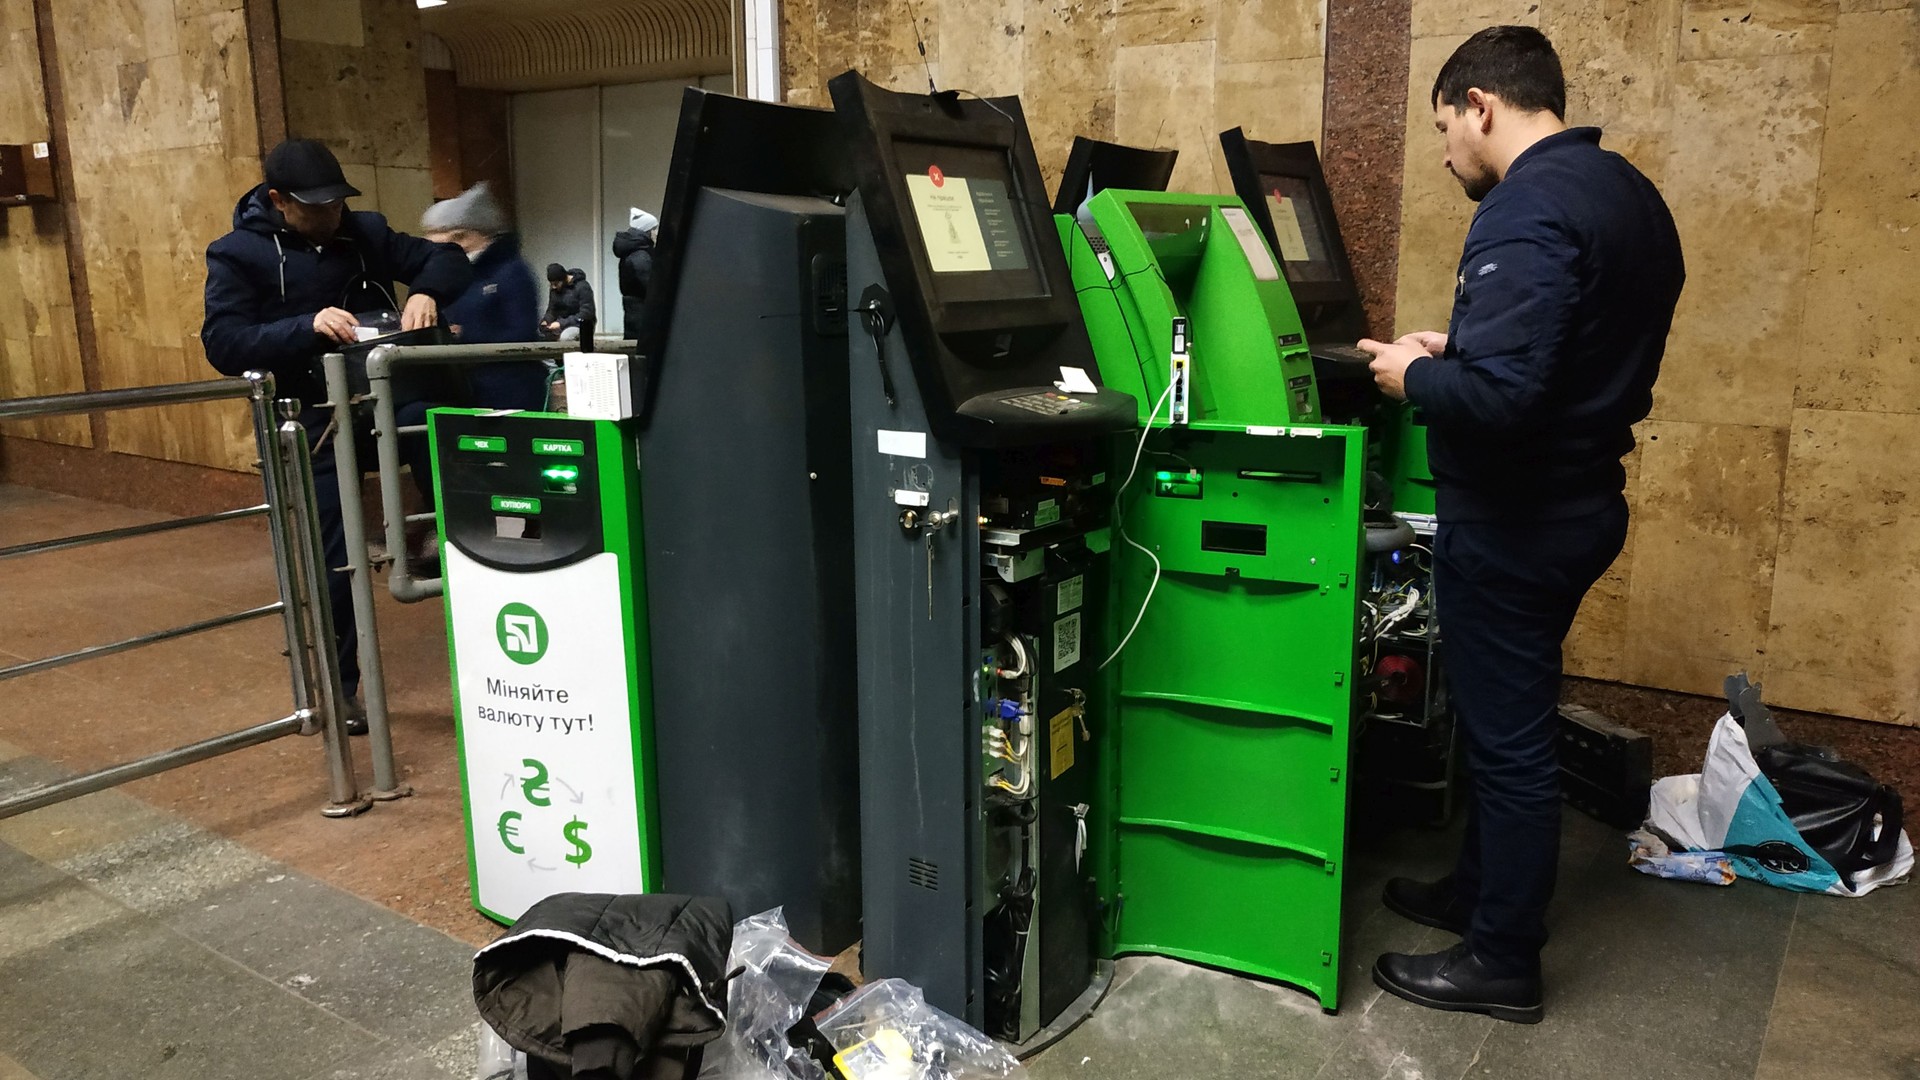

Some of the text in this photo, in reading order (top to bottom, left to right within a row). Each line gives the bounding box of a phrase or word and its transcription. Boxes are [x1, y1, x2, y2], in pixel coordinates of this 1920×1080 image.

[543, 444, 572, 452] КАРТКА
[500, 501, 531, 510] КУПЮРИ
[486, 676, 570, 704] Міняйте
[477, 705, 594, 736] валюту тут!
